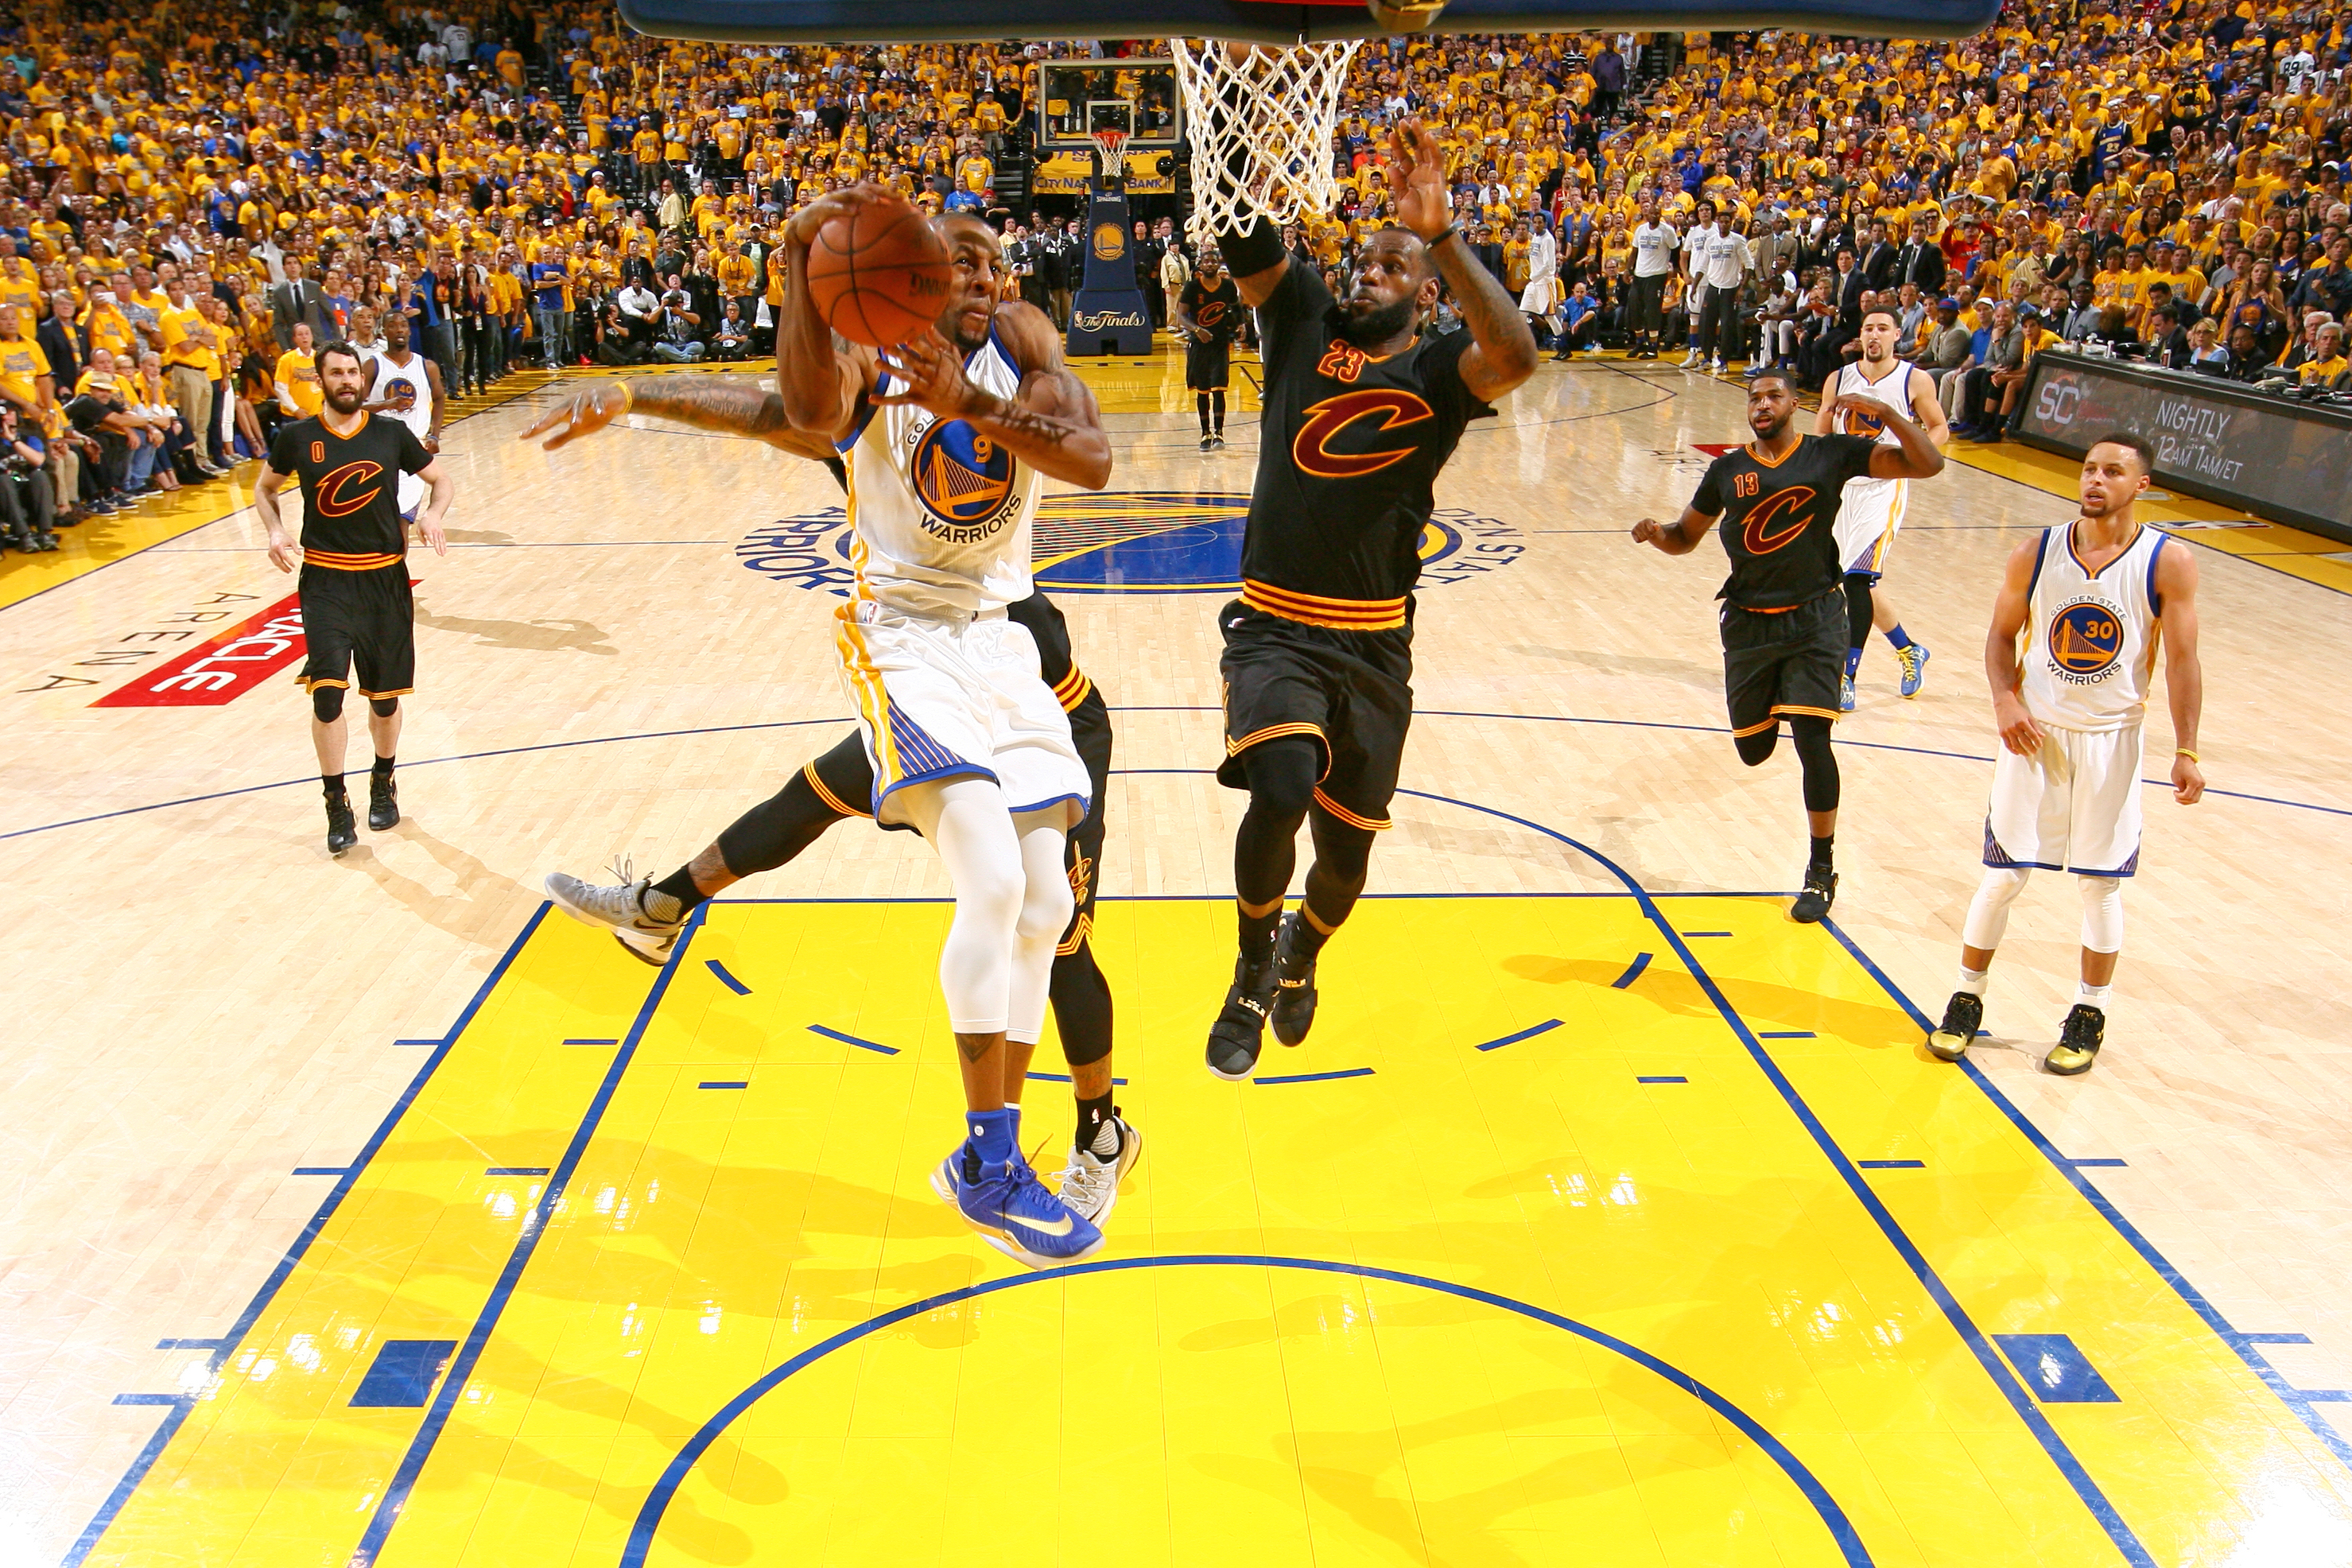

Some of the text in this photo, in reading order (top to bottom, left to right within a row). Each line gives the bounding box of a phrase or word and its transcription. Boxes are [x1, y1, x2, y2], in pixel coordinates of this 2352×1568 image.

[1128, 177, 1162, 188] BANK
[1082, 311, 1145, 331] The Finals
[1318, 339, 1365, 382] 23
[399, 384, 412, 394] 40
[2036, 382, 2079, 425] SC
[2155, 400, 2230, 440] NIGHTLY
[312, 441, 324, 463] 0
[973, 435, 992, 464] 9
[1733, 472, 1759, 499] 13
[920, 494, 1021, 543] WARRIORS
[735, 506, 854, 597] ARRIOR
[1412, 544, 1526, 589] STAT
[2050, 595, 2127, 621] GOLDEN STATE
[16, 592, 261, 693] ARENA
[2084, 621, 2113, 639] 30
[2047, 658, 2122, 685] WARRIORS
